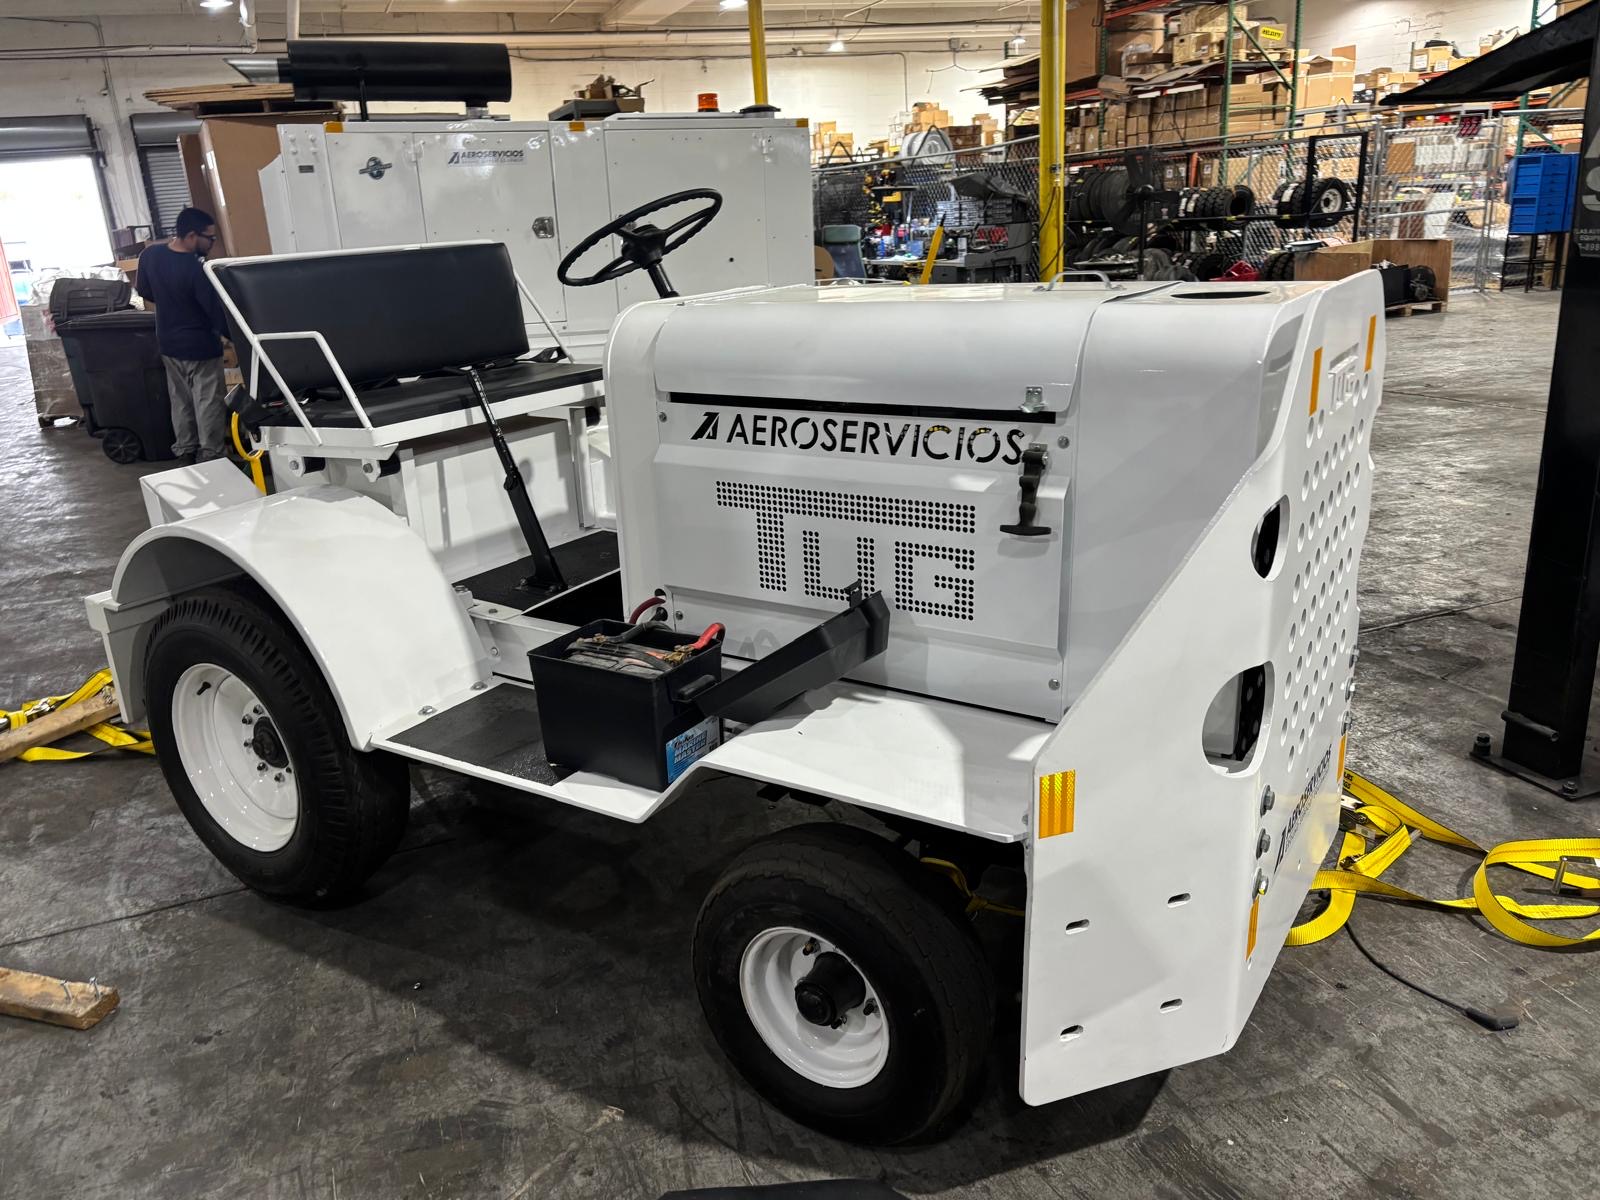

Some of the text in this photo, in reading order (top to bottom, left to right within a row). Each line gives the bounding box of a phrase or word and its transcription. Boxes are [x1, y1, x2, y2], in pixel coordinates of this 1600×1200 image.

[461, 150, 524, 159] AEROSERVICIOS
[727, 413, 1026, 466] AEROSERVICIOS
[716, 480, 976, 621] TUG
